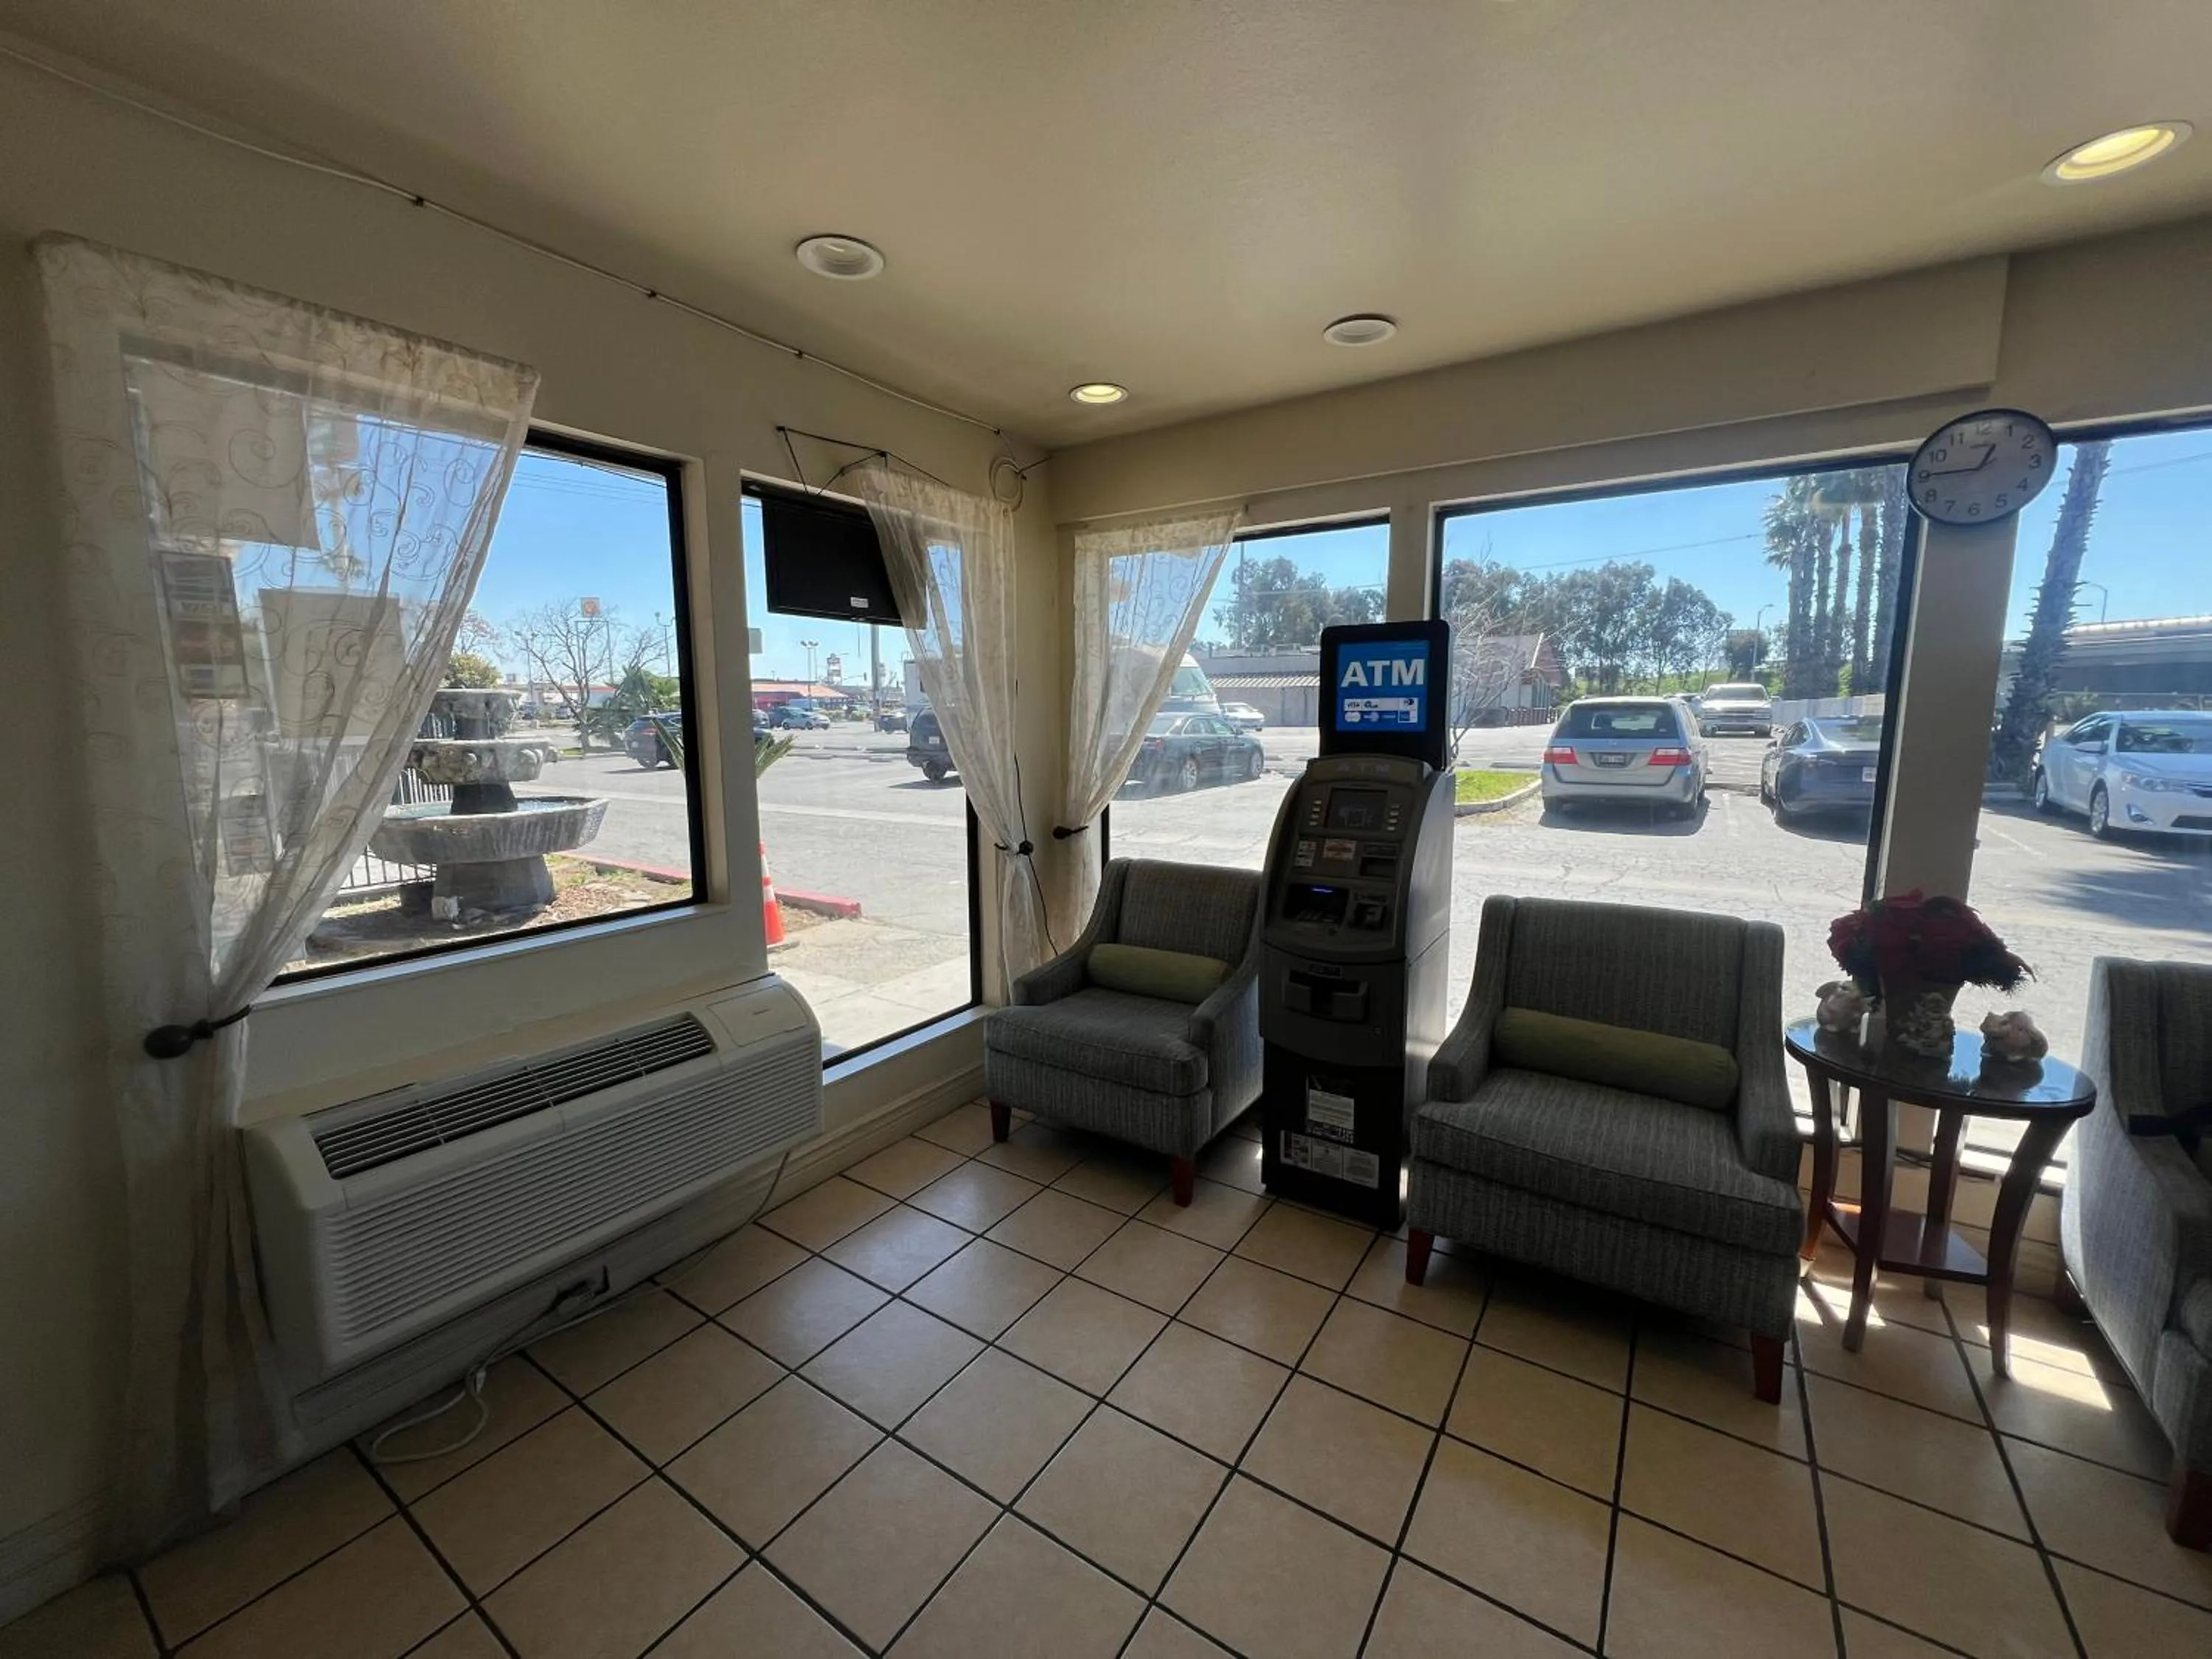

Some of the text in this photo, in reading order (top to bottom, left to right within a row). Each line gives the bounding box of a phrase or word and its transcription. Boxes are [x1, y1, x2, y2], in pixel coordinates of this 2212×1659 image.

[1976, 423, 1991, 435] 12
[2006, 425, 2013, 437] 1
[1950, 433, 1964, 446] 11
[2022, 435, 2035, 449] 2
[1929, 449, 1947, 464] 10
[2028, 453, 2042, 469] 3
[1919, 470, 1930, 483] 9
[2017, 478, 2028, 491] 4
[1924, 489, 1937, 503] 8
[1995, 493, 2008, 508] 5
[1945, 500, 1956, 513] 7
[1968, 503, 1980, 516] 6
[1340, 658, 1425, 687] ATM
